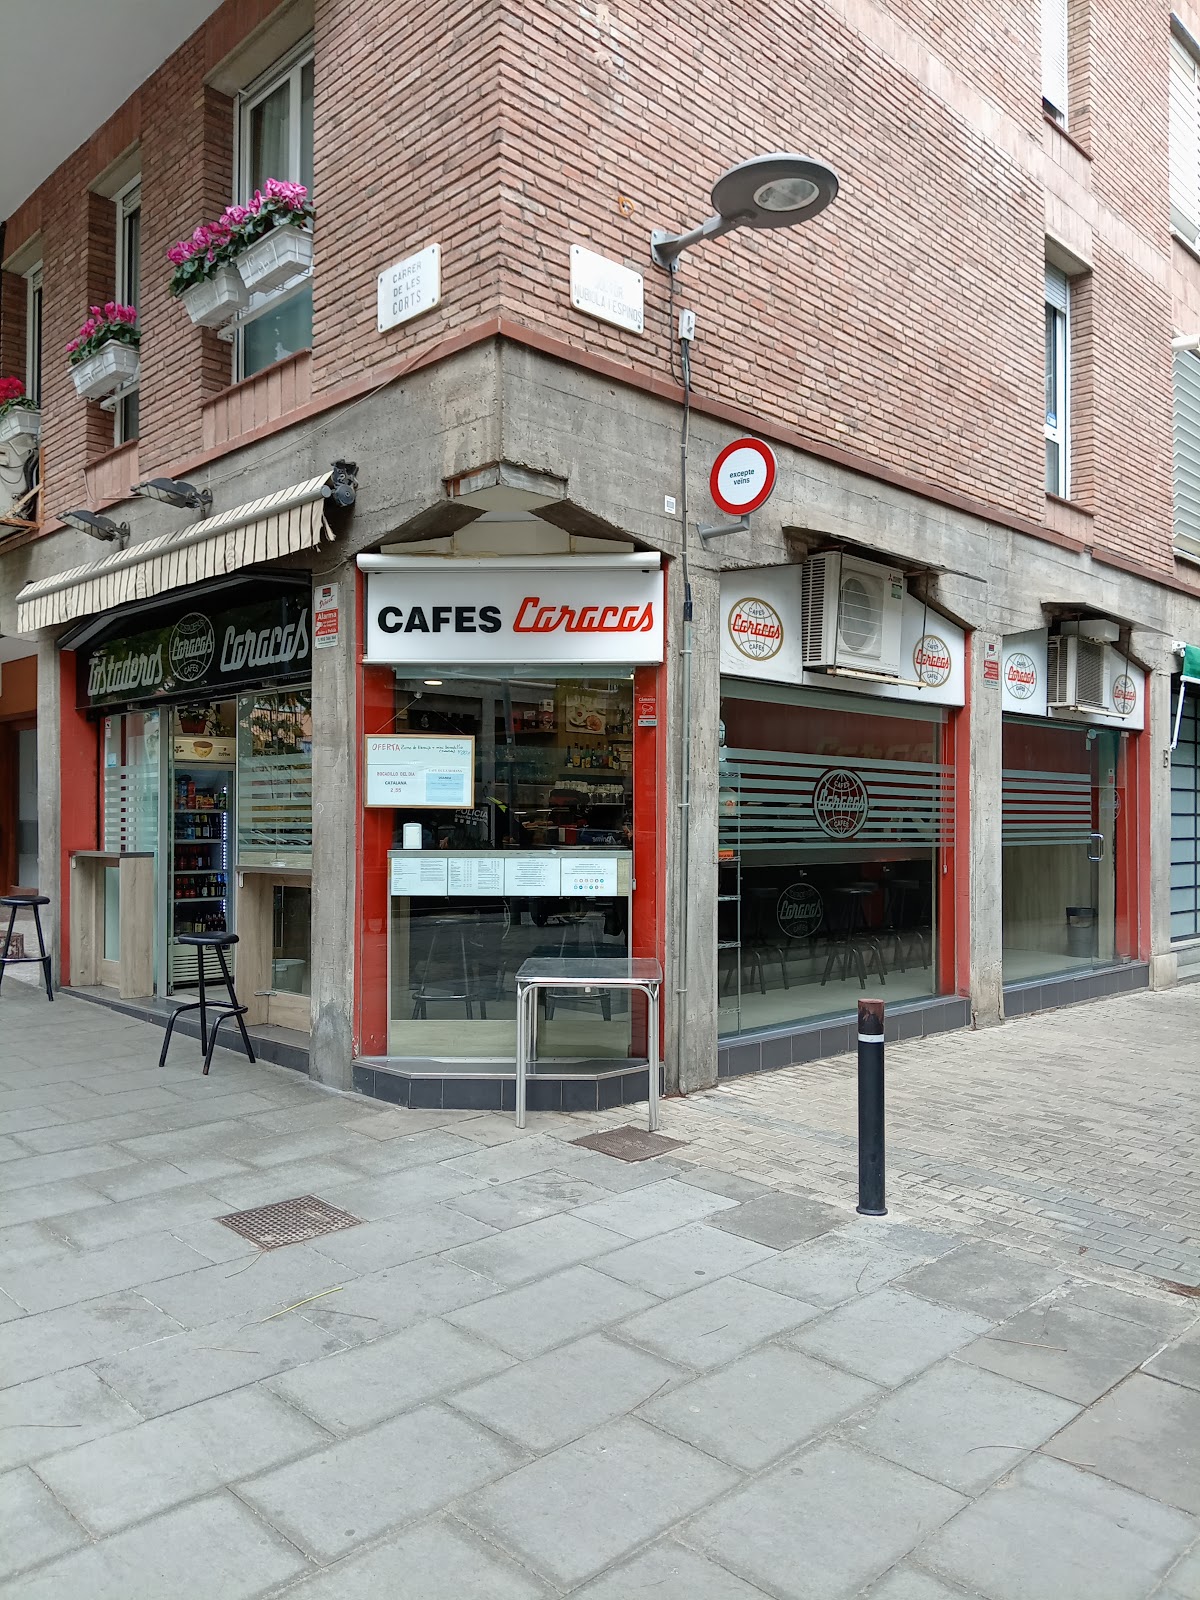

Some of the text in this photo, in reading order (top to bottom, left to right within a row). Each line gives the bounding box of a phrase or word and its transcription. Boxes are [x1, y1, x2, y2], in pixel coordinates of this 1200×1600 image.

[393, 261, 422, 284] CARRER
[393, 275, 421, 297] DE LES
[393, 290, 421, 315] CORTS
[729, 469, 755, 478] excepte
[377, 596, 654, 634] CAFES Caracas
[733, 613, 780, 639] Caracas
[172, 629, 213, 661] Caracas
[220, 608, 309, 672] Caracas
[87, 644, 163, 696] Tostaderos
[916, 649, 949, 669] Caracas
[372, 743, 401, 751] OFERTA
[818, 788, 865, 811] Caracas
[780, 899, 822, 919] Caracas
